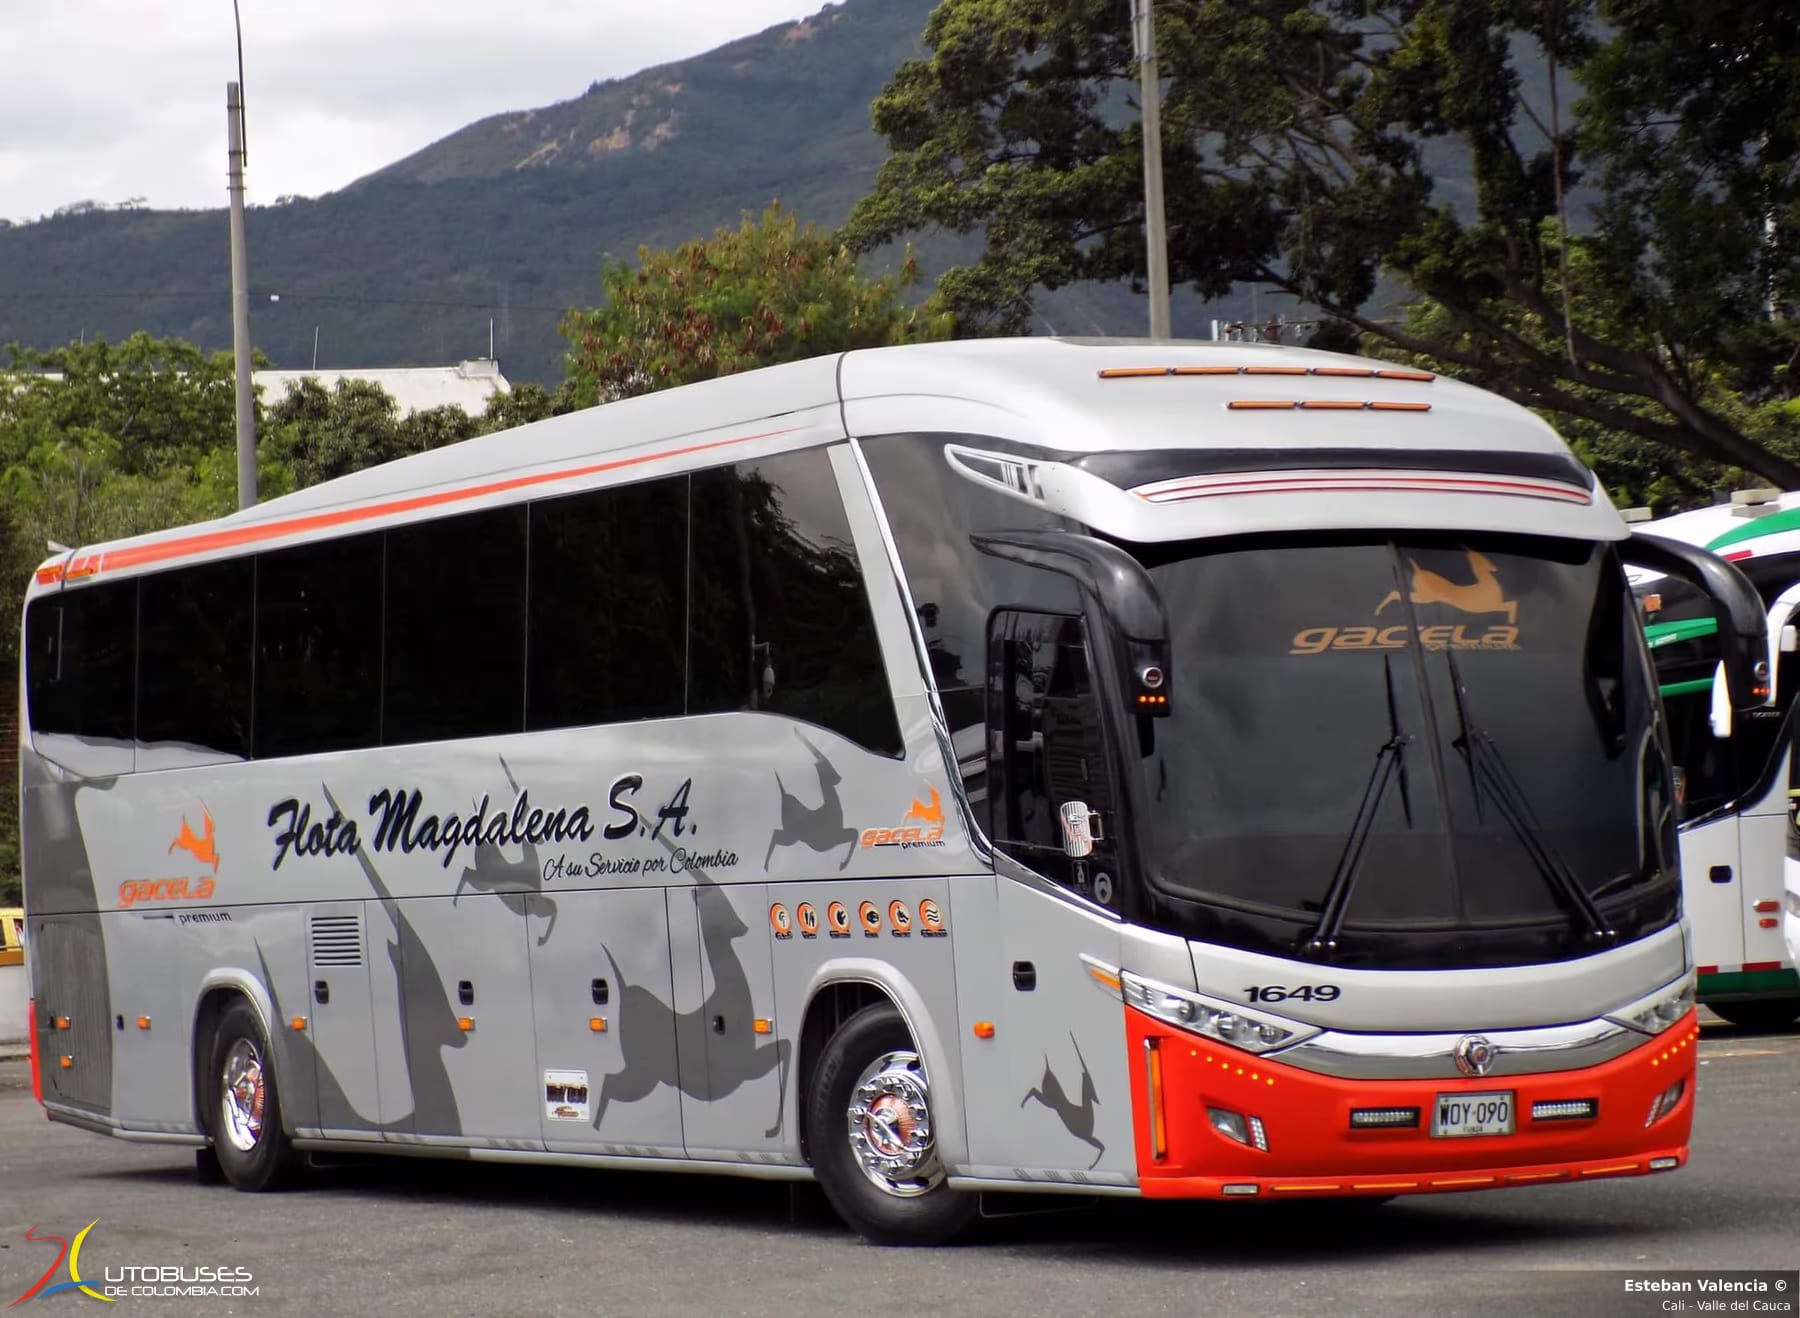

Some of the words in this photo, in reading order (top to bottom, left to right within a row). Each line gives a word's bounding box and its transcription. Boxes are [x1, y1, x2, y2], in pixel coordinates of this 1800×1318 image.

[268, 798, 361, 871] Flota
[369, 788, 594, 869] Magdalena
[566, 862, 583, 877] su
[584, 853, 641, 878] Servicio
[642, 857, 668, 877] por
[669, 847, 739, 874] Colombia
[179, 912, 232, 926] premium
[1243, 984, 1341, 1003] 1649
